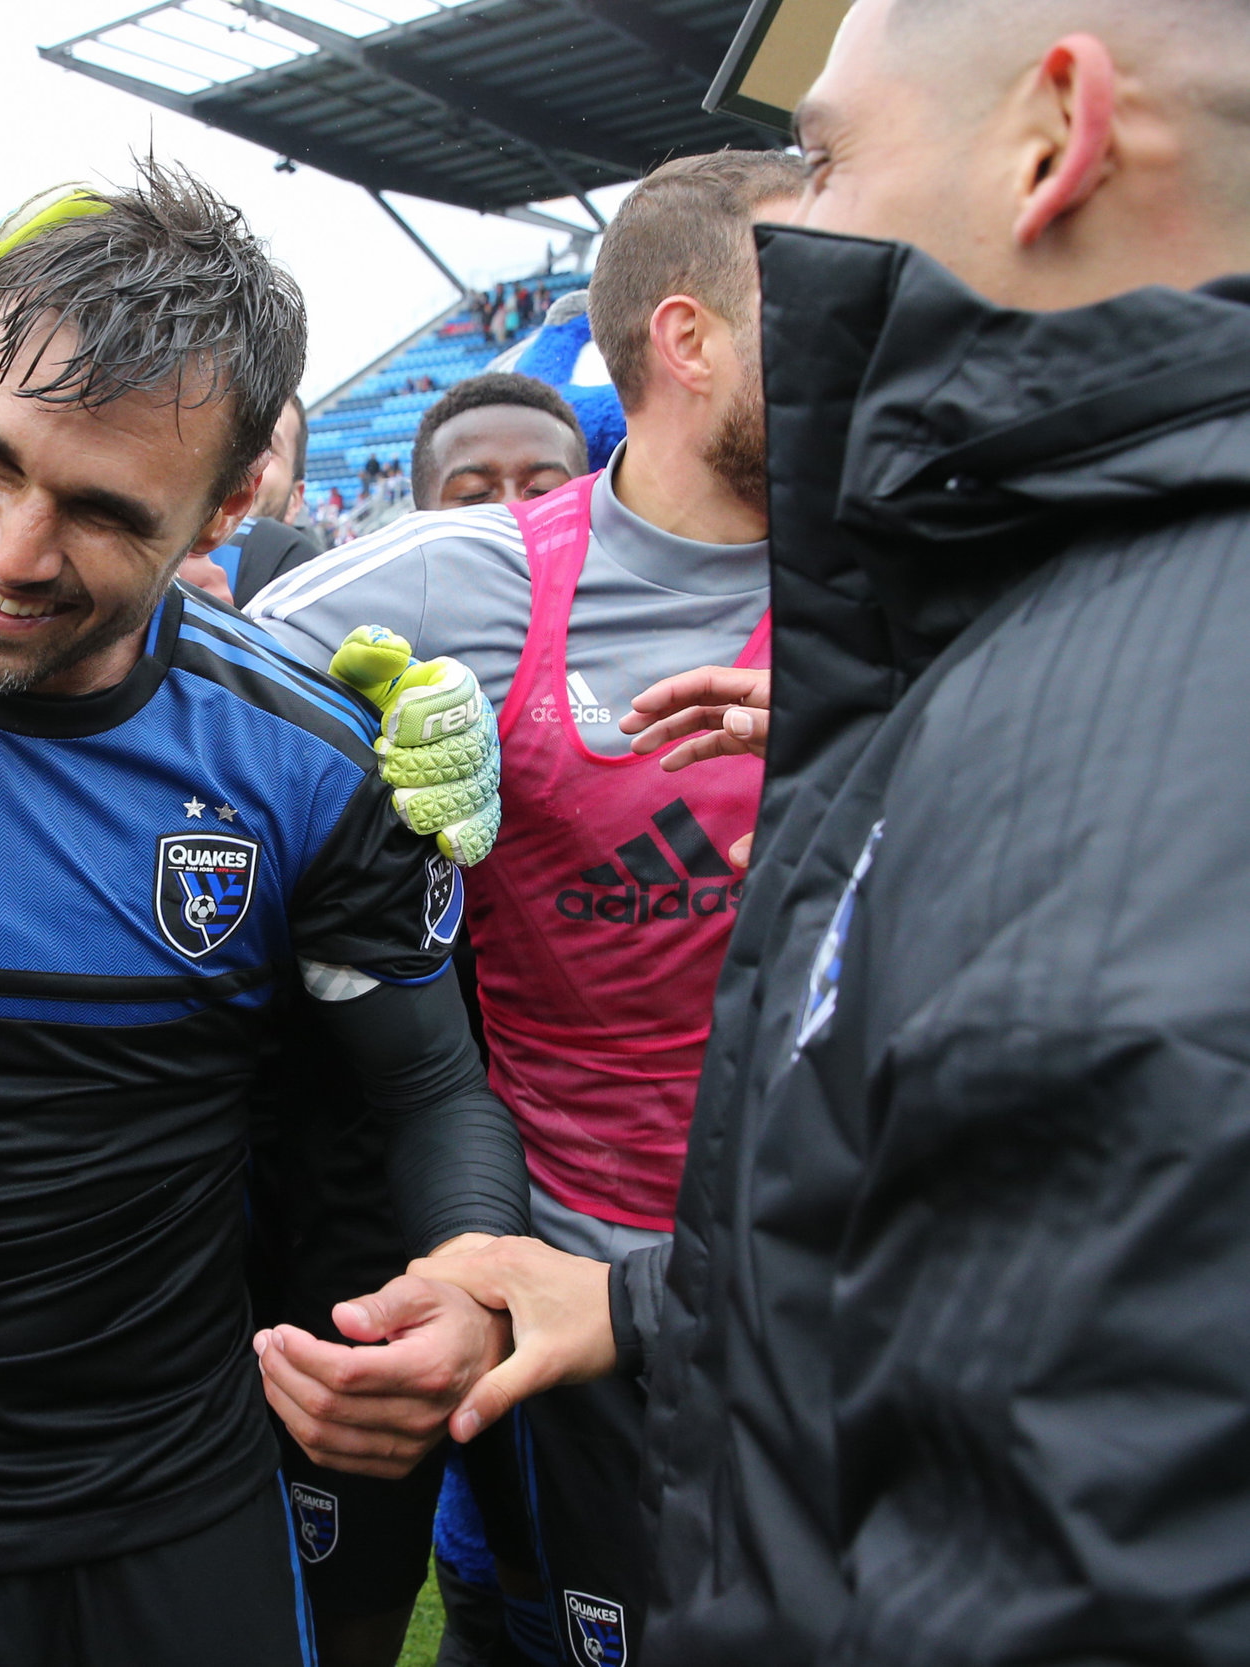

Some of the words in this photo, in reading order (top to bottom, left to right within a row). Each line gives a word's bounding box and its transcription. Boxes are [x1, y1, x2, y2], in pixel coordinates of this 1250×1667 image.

[530, 703, 611, 723] addas
[168, 844, 248, 868] QUAKES
[294, 1488, 333, 1511] QUAKES
[569, 1596, 618, 1623] QUAKES
